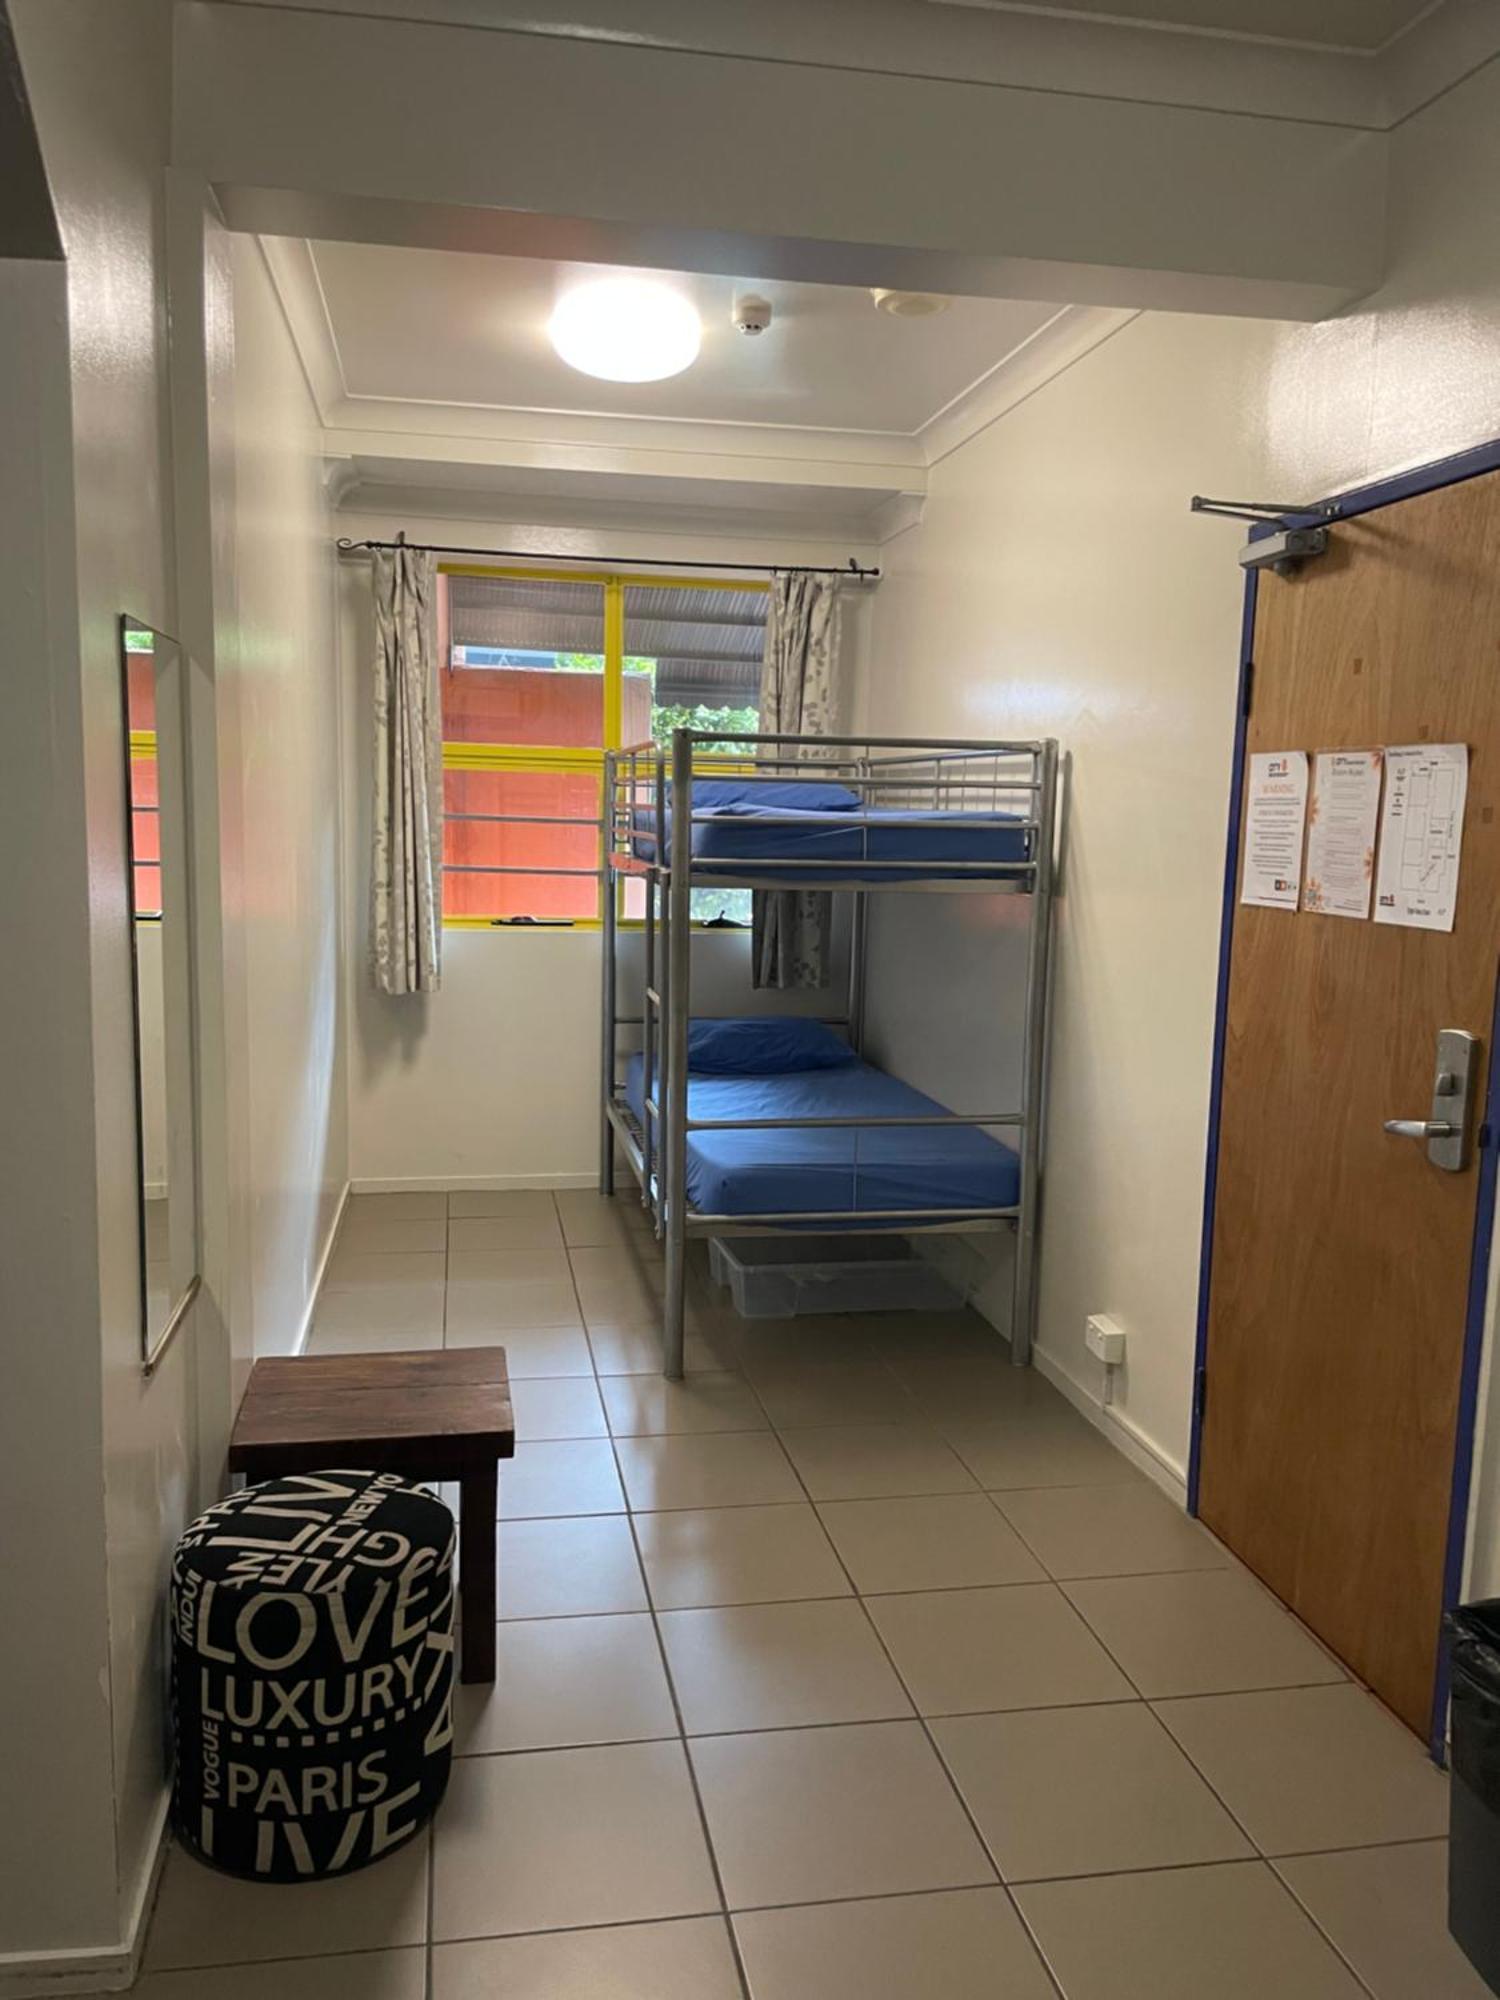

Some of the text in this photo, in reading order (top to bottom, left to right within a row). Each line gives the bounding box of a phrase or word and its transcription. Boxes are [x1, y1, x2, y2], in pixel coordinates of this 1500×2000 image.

[197, 1562, 434, 1670] LOVE
[202, 1641, 425, 1729] LUXURY
[203, 1718, 220, 1799] VOGUE
[227, 1750, 387, 1816] PARIS
